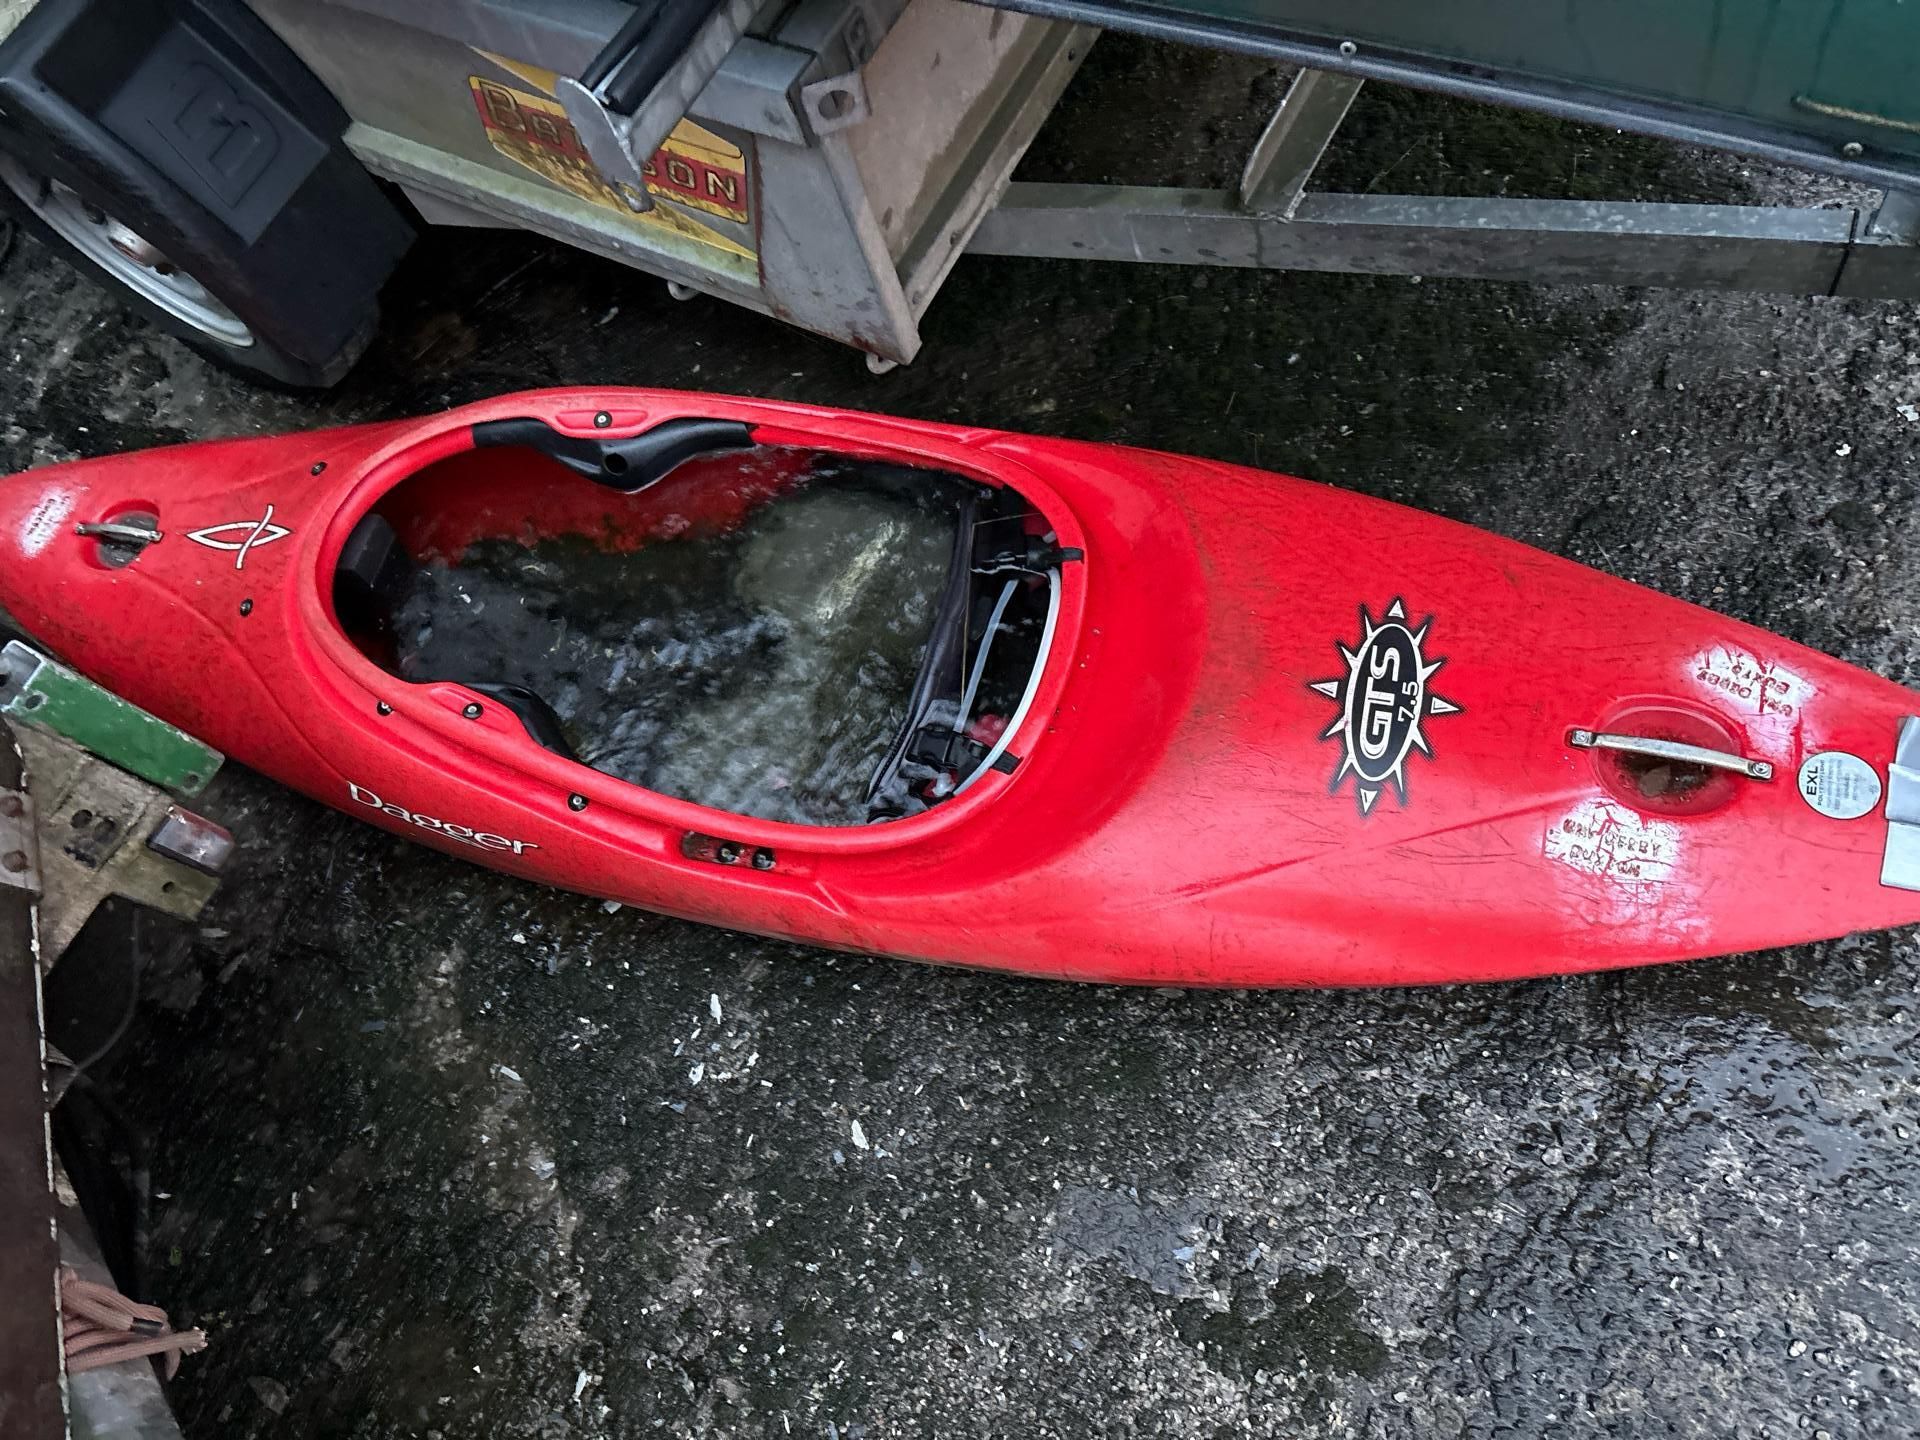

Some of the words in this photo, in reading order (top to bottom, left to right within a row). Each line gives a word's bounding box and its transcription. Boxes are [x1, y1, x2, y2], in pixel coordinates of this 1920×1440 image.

[479, 79, 738, 203] BASON
[1359, 645, 1401, 760] GTS
[1398, 681, 1420, 722] 7.5
[346, 780, 539, 855] Dagger
[1806, 766, 1819, 796] EXL
